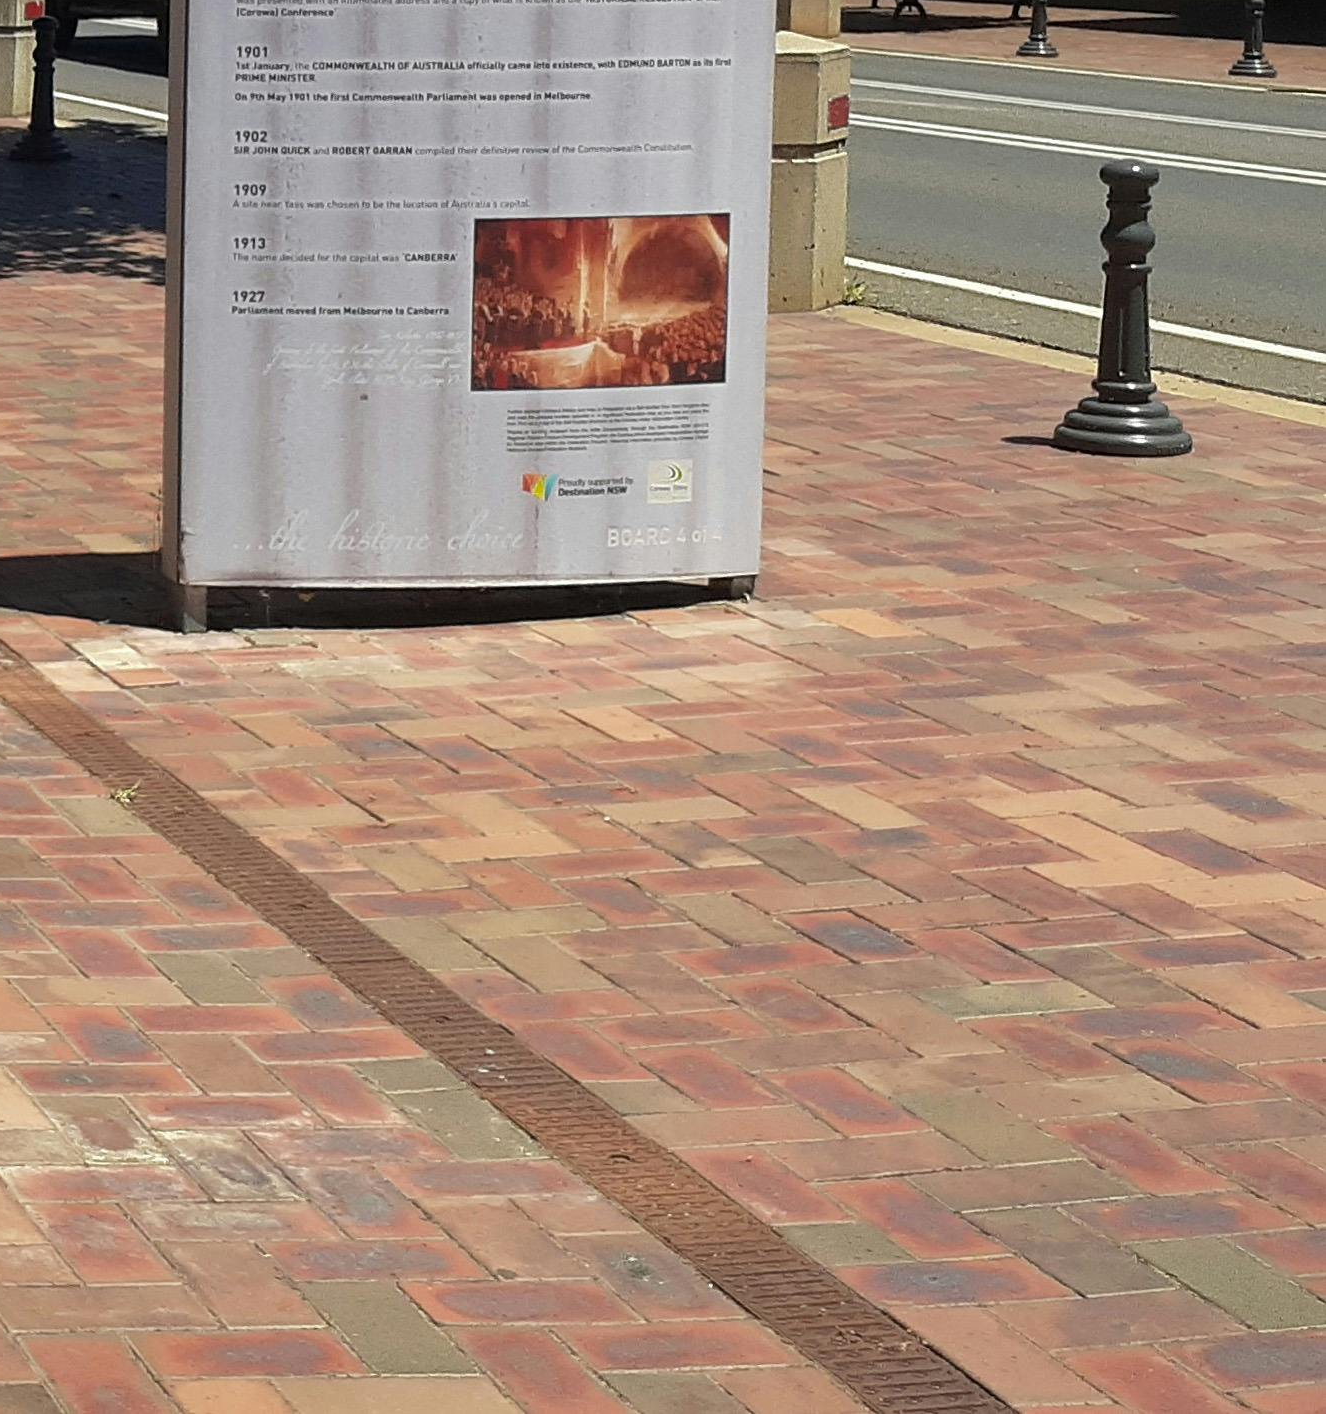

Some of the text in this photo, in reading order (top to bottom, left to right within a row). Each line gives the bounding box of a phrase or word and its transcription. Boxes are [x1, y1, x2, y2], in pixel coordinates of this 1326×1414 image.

[236, 44, 268, 58] 1901
[234, 72, 316, 83] PRIME MINISTER
[235, 129, 268, 143] 1902
[234, 183, 267, 197] 1909
[233, 236, 266, 250] 1913
[232, 289, 266, 303] 1927
[231, 304, 450, 316] Parliament moved from Melbourne to Canberra
[558, 485, 628, 497] Destination NSW
[328, 508, 431, 552] historic
[447, 508, 525, 552] choice
